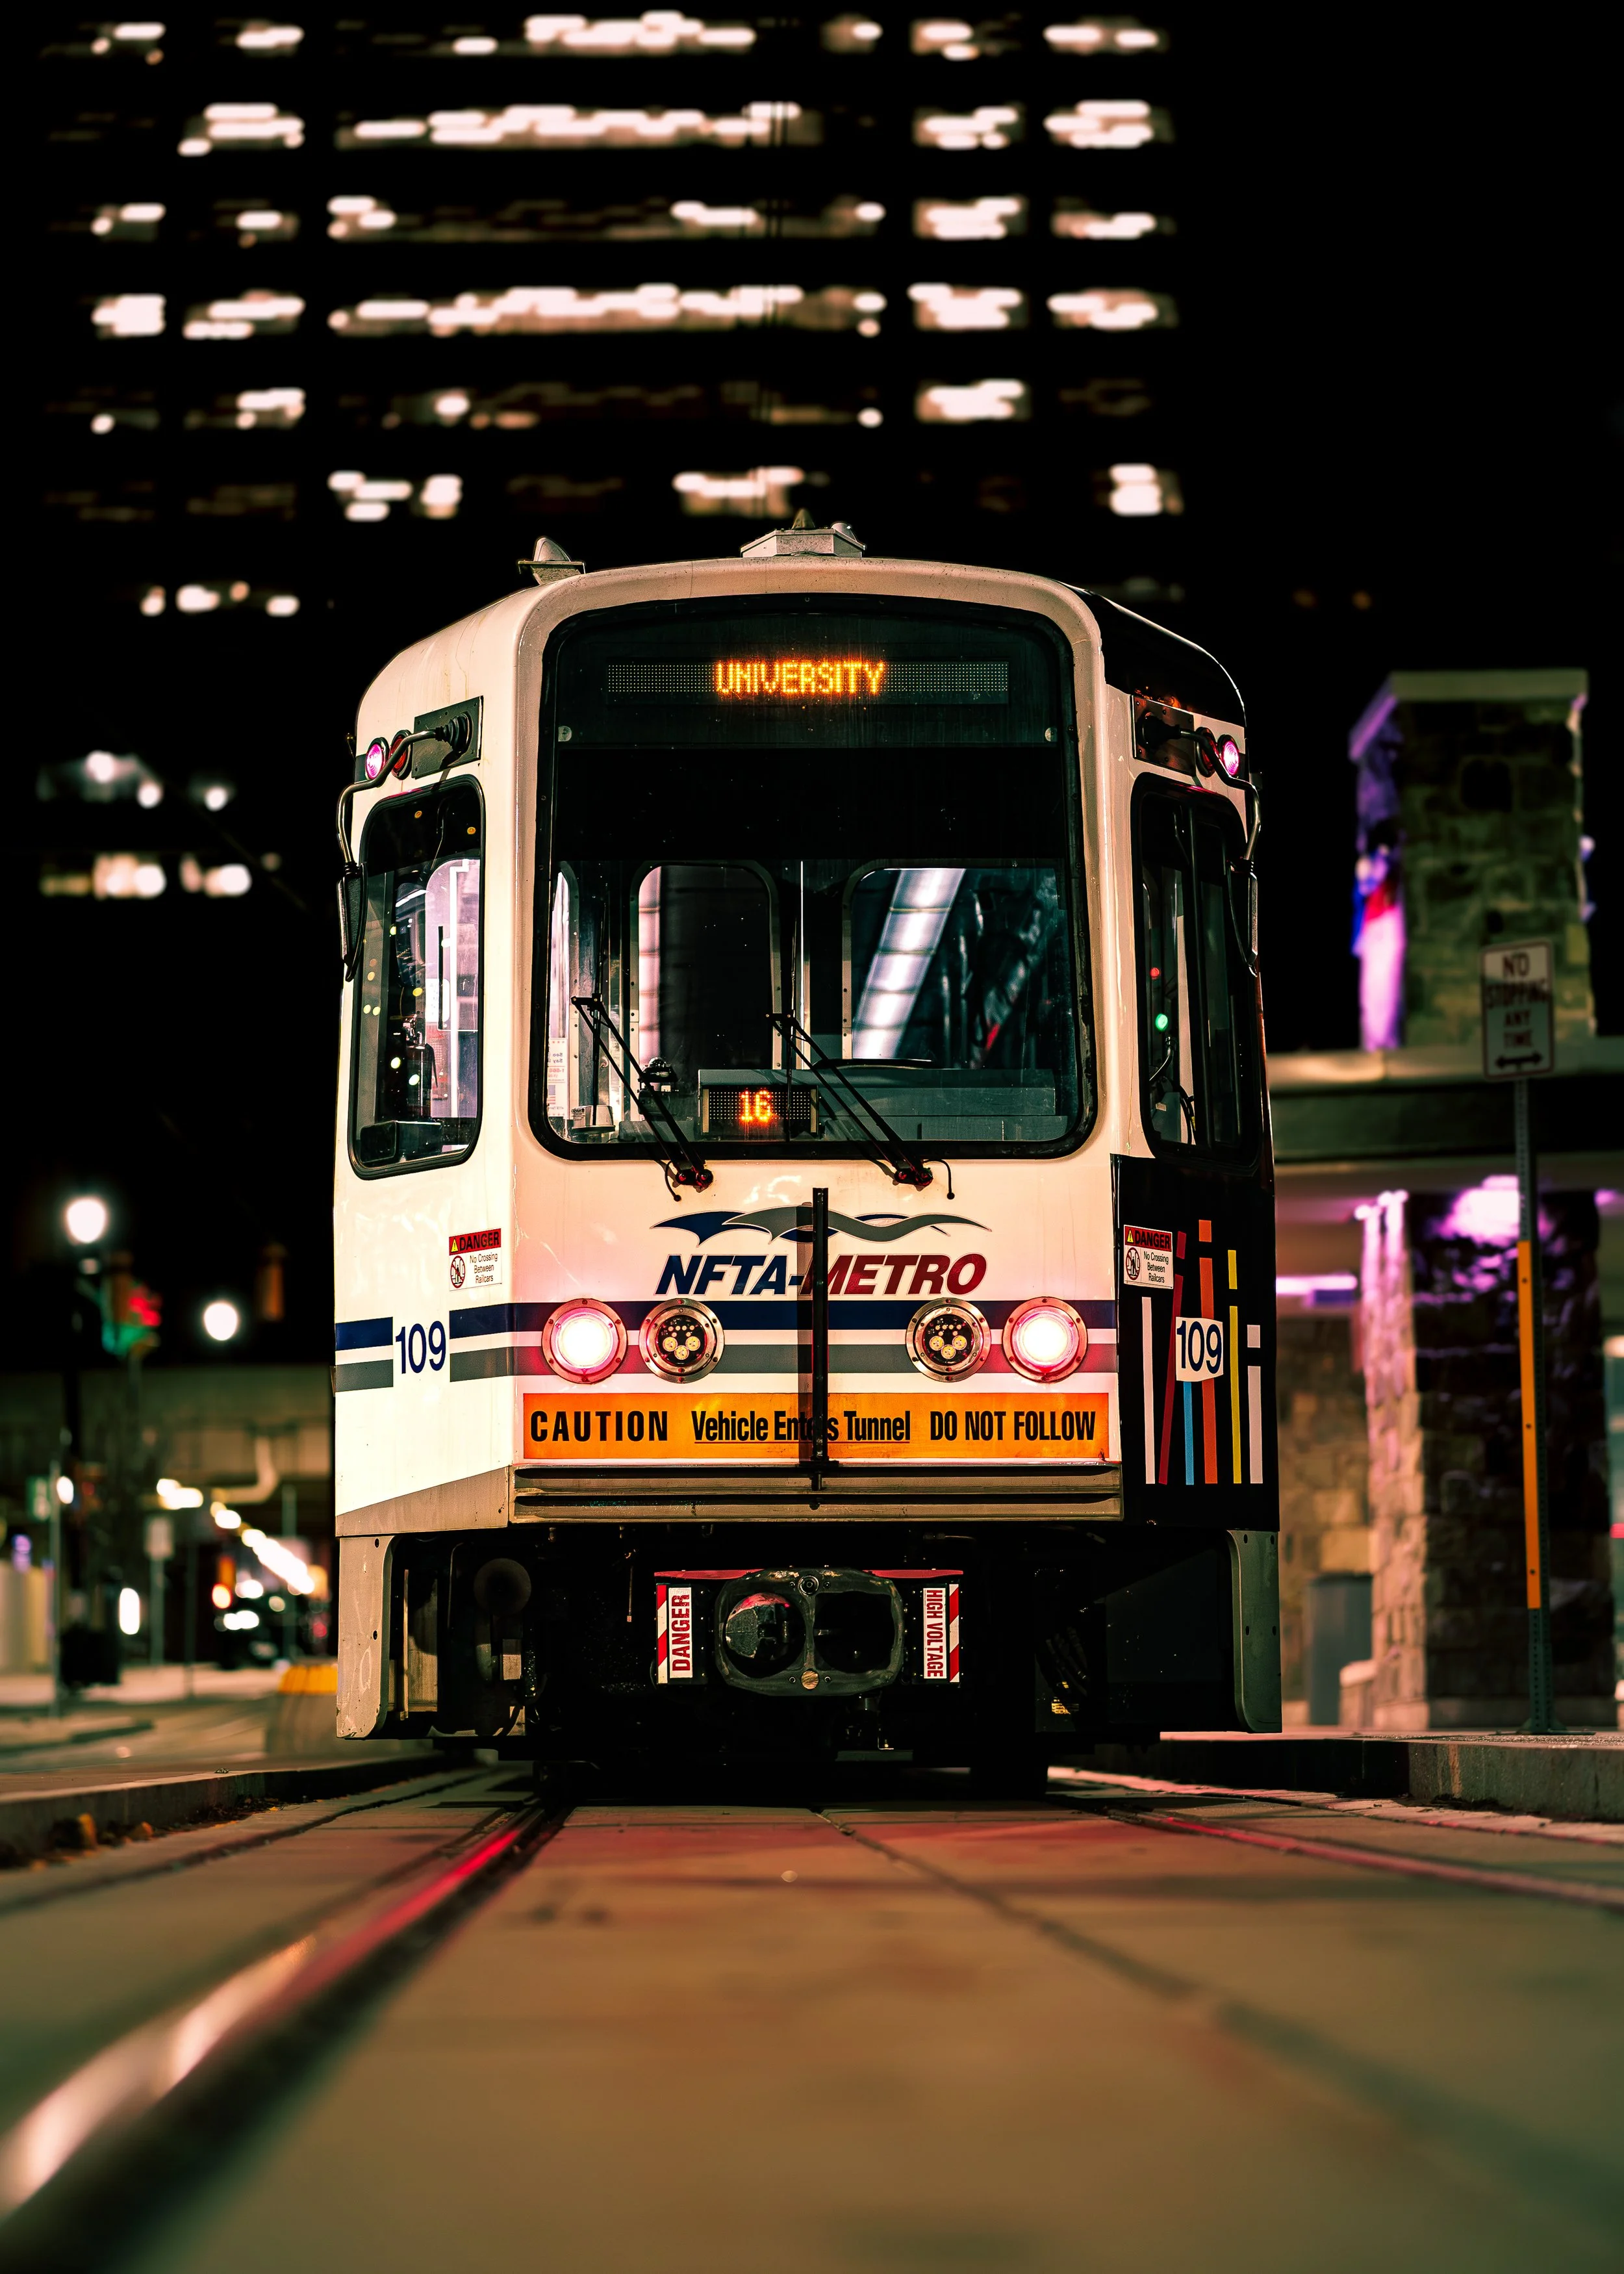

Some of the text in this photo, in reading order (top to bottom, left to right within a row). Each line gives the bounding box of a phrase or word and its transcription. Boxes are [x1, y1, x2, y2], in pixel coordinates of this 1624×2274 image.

[717, 661, 884, 694] UNIVERSITY
[1503, 952, 1530, 977] NO
[741, 1090, 772, 1121] 16
[459, 1231, 500, 1251] DANGER
[1134, 1230, 1170, 1249] DANGER
[474, 1264, 494, 1273] Between
[477, 1252, 498, 1262] Crossing
[1143, 1251, 1169, 1265] No Crossing
[1147, 1262, 1165, 1273] Between
[476, 1275, 494, 1283] Railcars
[654, 1254, 986, 1295] NFTA-METRO
[1148, 1273, 1165, 1283] Railcars
[394, 1320, 446, 1374] 109
[1176, 1318, 1223, 1374] 109
[531, 1411, 668, 1442] CAUTION
[691, 1411, 911, 1441] Vehicle Ents Tunnel
[930, 1411, 1096, 1441] DO NOT FOLLOW
[671, 1594, 691, 1671] DANGER
[926, 1589, 944, 1678] HIGH VOLTAGE
